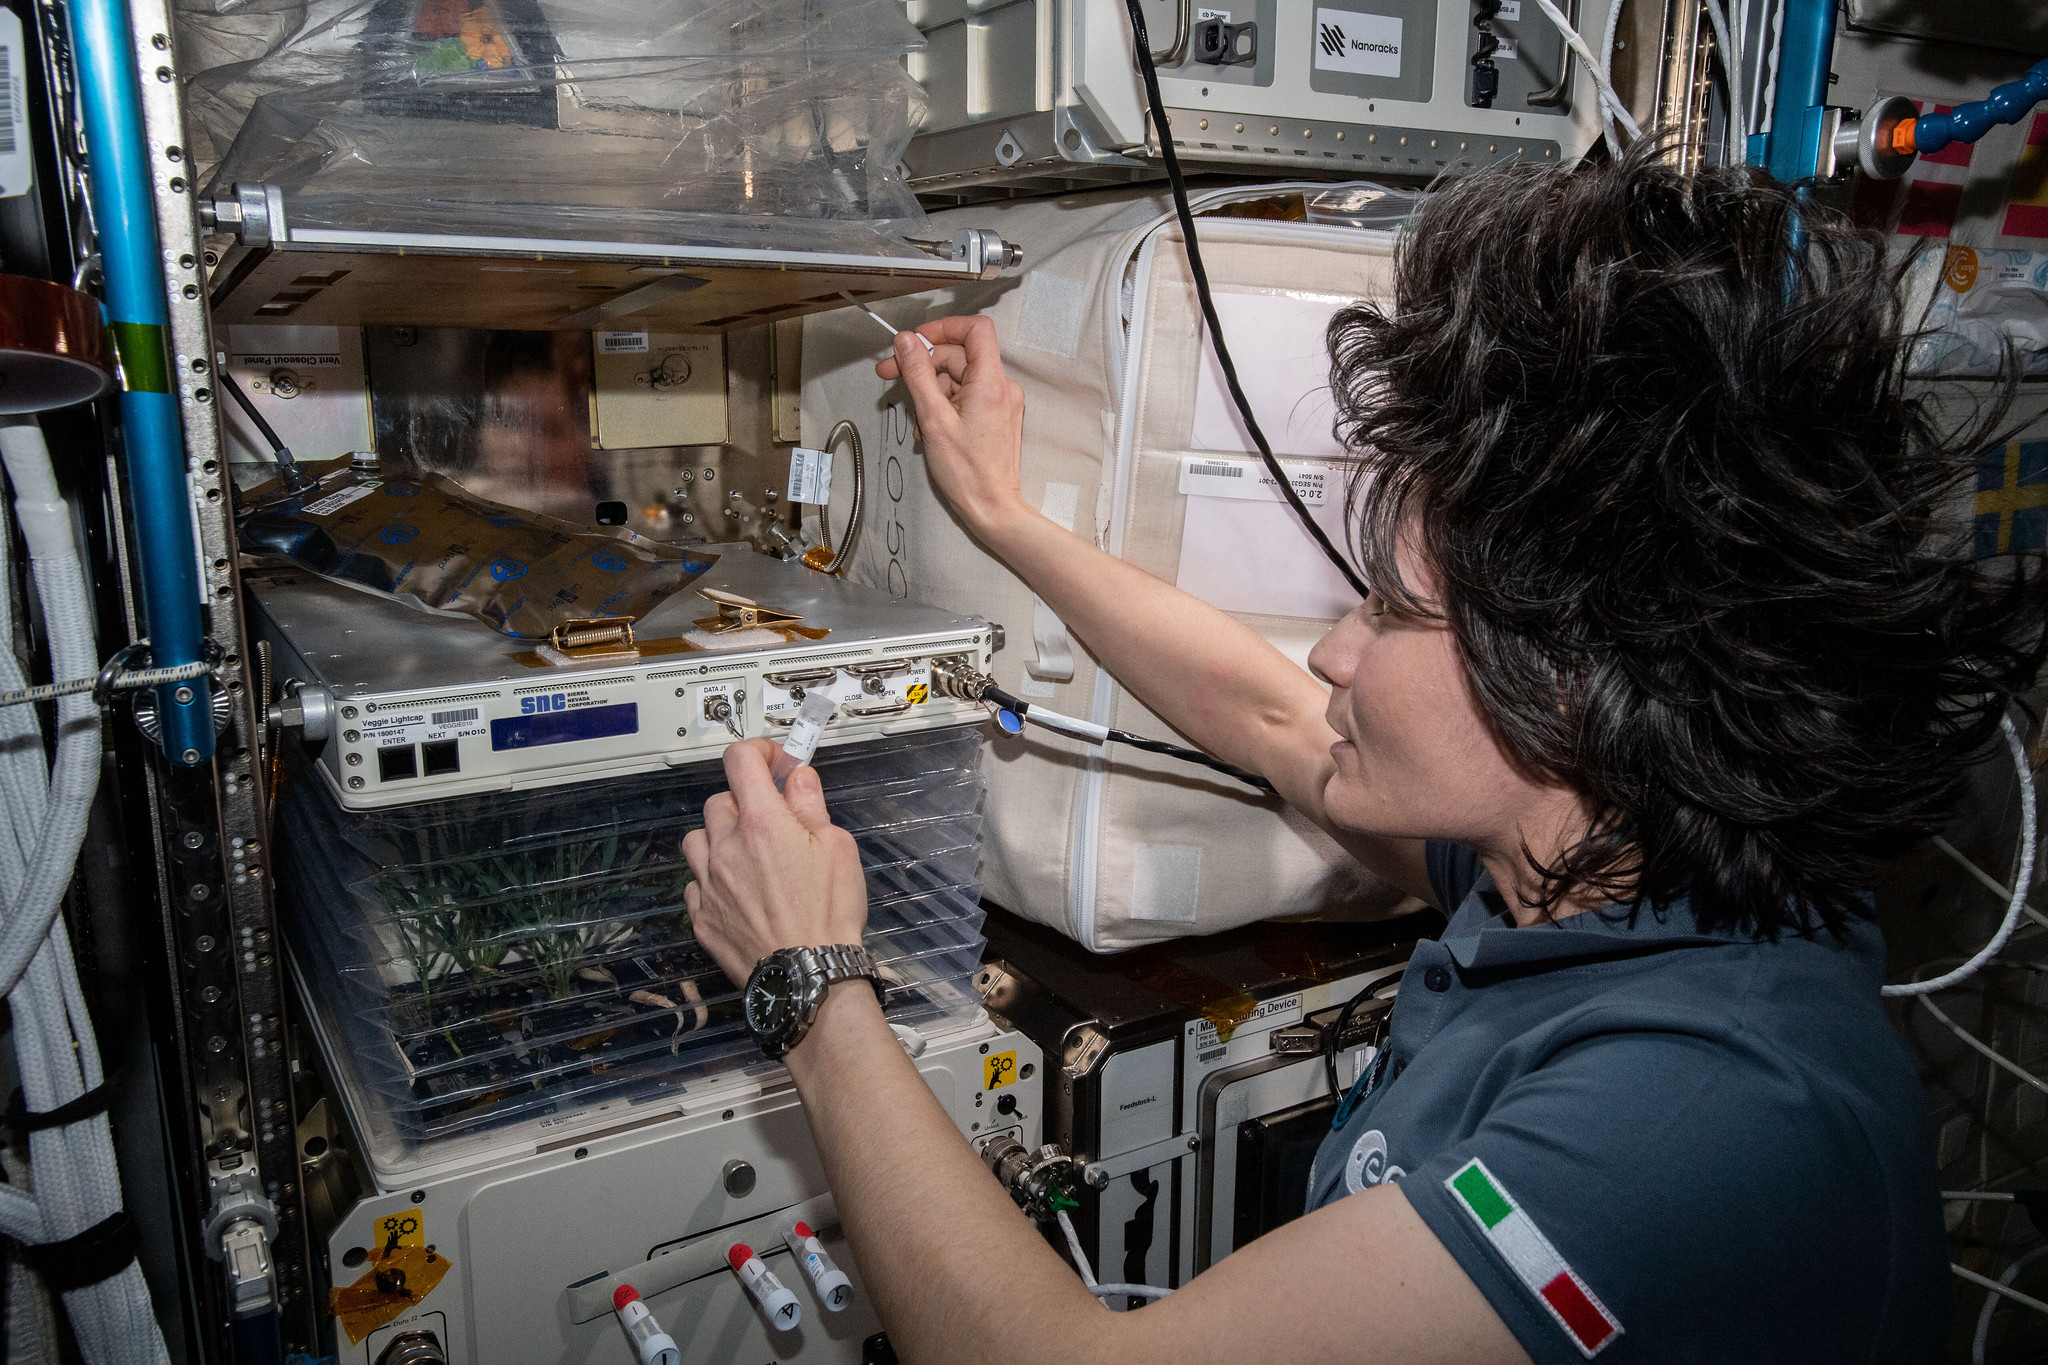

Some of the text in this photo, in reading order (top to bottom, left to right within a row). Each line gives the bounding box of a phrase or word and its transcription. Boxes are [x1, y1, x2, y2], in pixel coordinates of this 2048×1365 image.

[1210, 11, 1227, 19] Power
[1351, 39, 1399, 55] Nanoracks
[244, 356, 340, 366] Vent Closeout Panel
[1309, 490, 1322, 498] 2.0
[906, 668, 926, 676] POWER
[567, 690, 589, 698] SIERRA
[844, 693, 863, 701] CLOSE
[520, 692, 567, 715] snc
[567, 698, 609, 709] CORPORATION
[766, 703, 785, 711] RESET
[792, 700, 802, 708] ON
[362, 713, 424, 728] Veggie Lightcap
[438, 720, 474, 730] VEGGIE010
[377, 728, 405, 737] 1800147
[428, 731, 447, 740] NEXT
[457, 730, 471, 738] S/N
[382, 736, 406, 745] ENTER
[1267, 998, 1297, 1015] Device
[1119, 1095, 1157, 1112] Feedstock-L
[984, 1122, 1000, 1131] Unlock
[393, 1318, 409, 1327] Data
